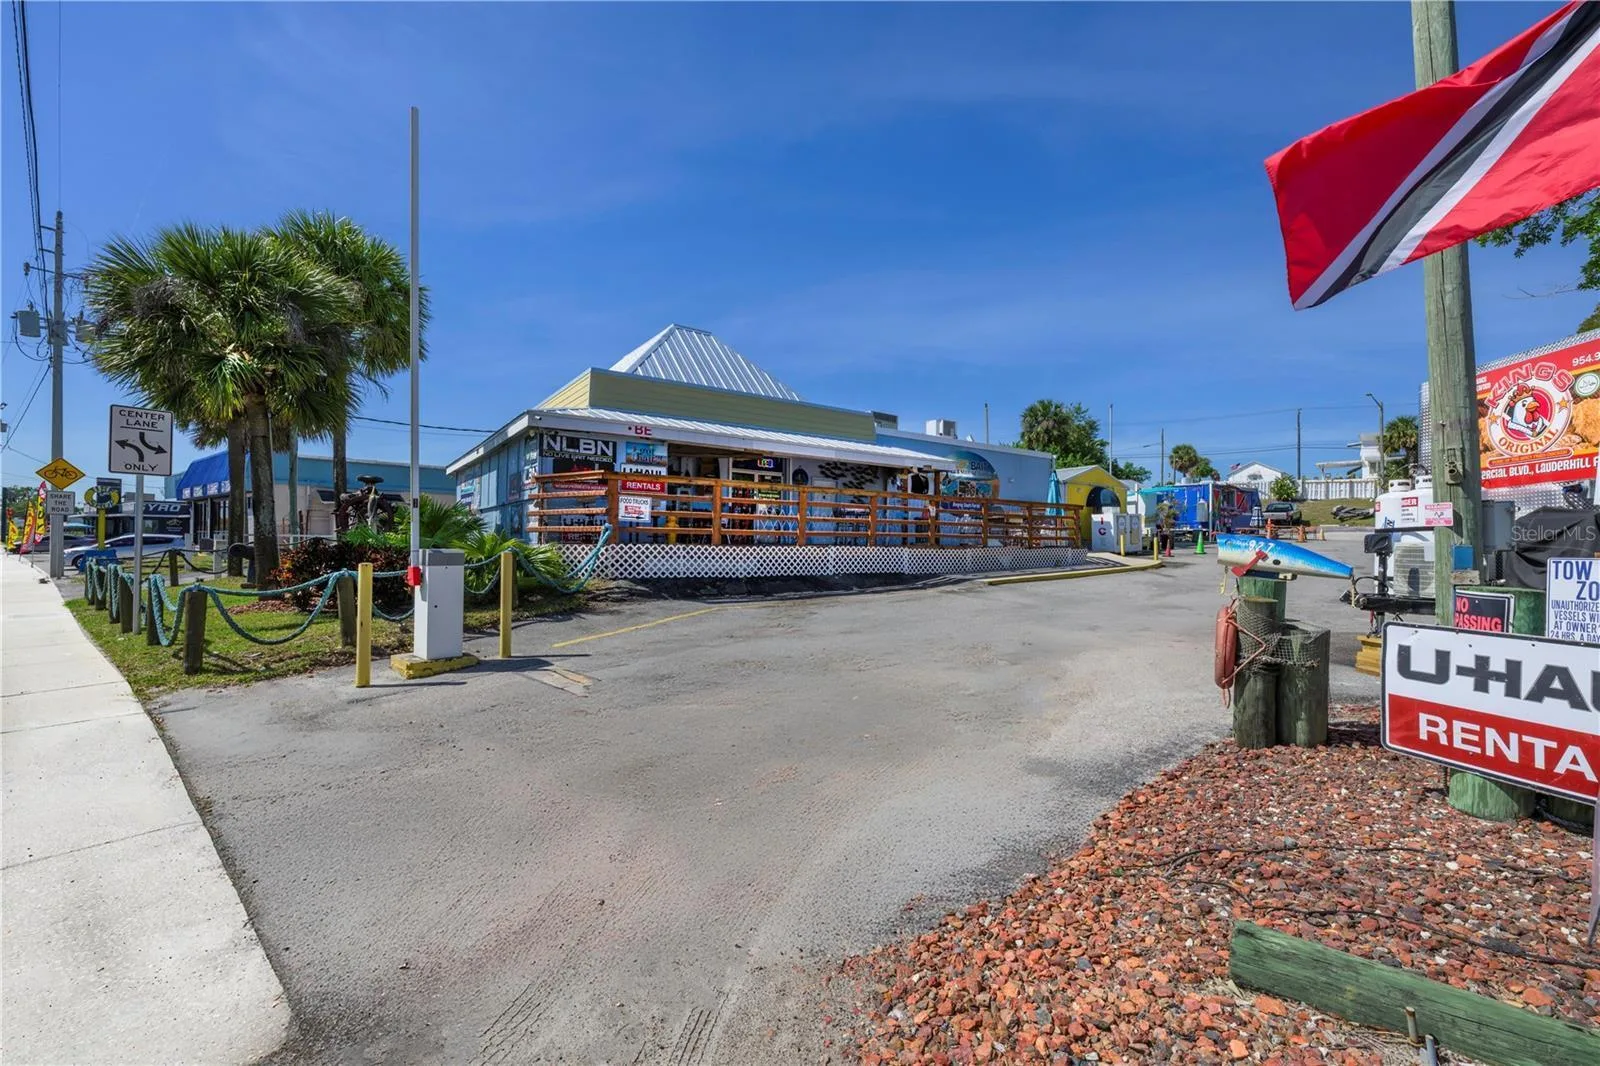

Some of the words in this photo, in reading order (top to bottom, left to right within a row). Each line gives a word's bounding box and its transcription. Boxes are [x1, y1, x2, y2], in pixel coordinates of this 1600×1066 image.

[1484, 362, 1575, 408] KINGS
[119, 409, 165, 421] CENTER
[126, 419, 158, 429] LANE
[543, 434, 613, 457] NLBN
[1498, 428, 1559, 454] ORIGINAL
[124, 463, 159, 472] ONLY
[626, 481, 661, 491] RENTALS
[142, 502, 181, 512] YRO
[632, 498, 649, 506] TRUCKS
[1552, 560, 1593, 580] TOW
[1576, 581, 1600, 601] ZO
[1456, 597, 1469, 613] NO
[1551, 600, 1600, 613] UNAUTHORIZE
[1554, 610, 1587, 623] VESSELS
[1553, 620, 1564, 631] AT
[1550, 630, 1560, 639] 24
[1419, 712, 1599, 784] RENTA
